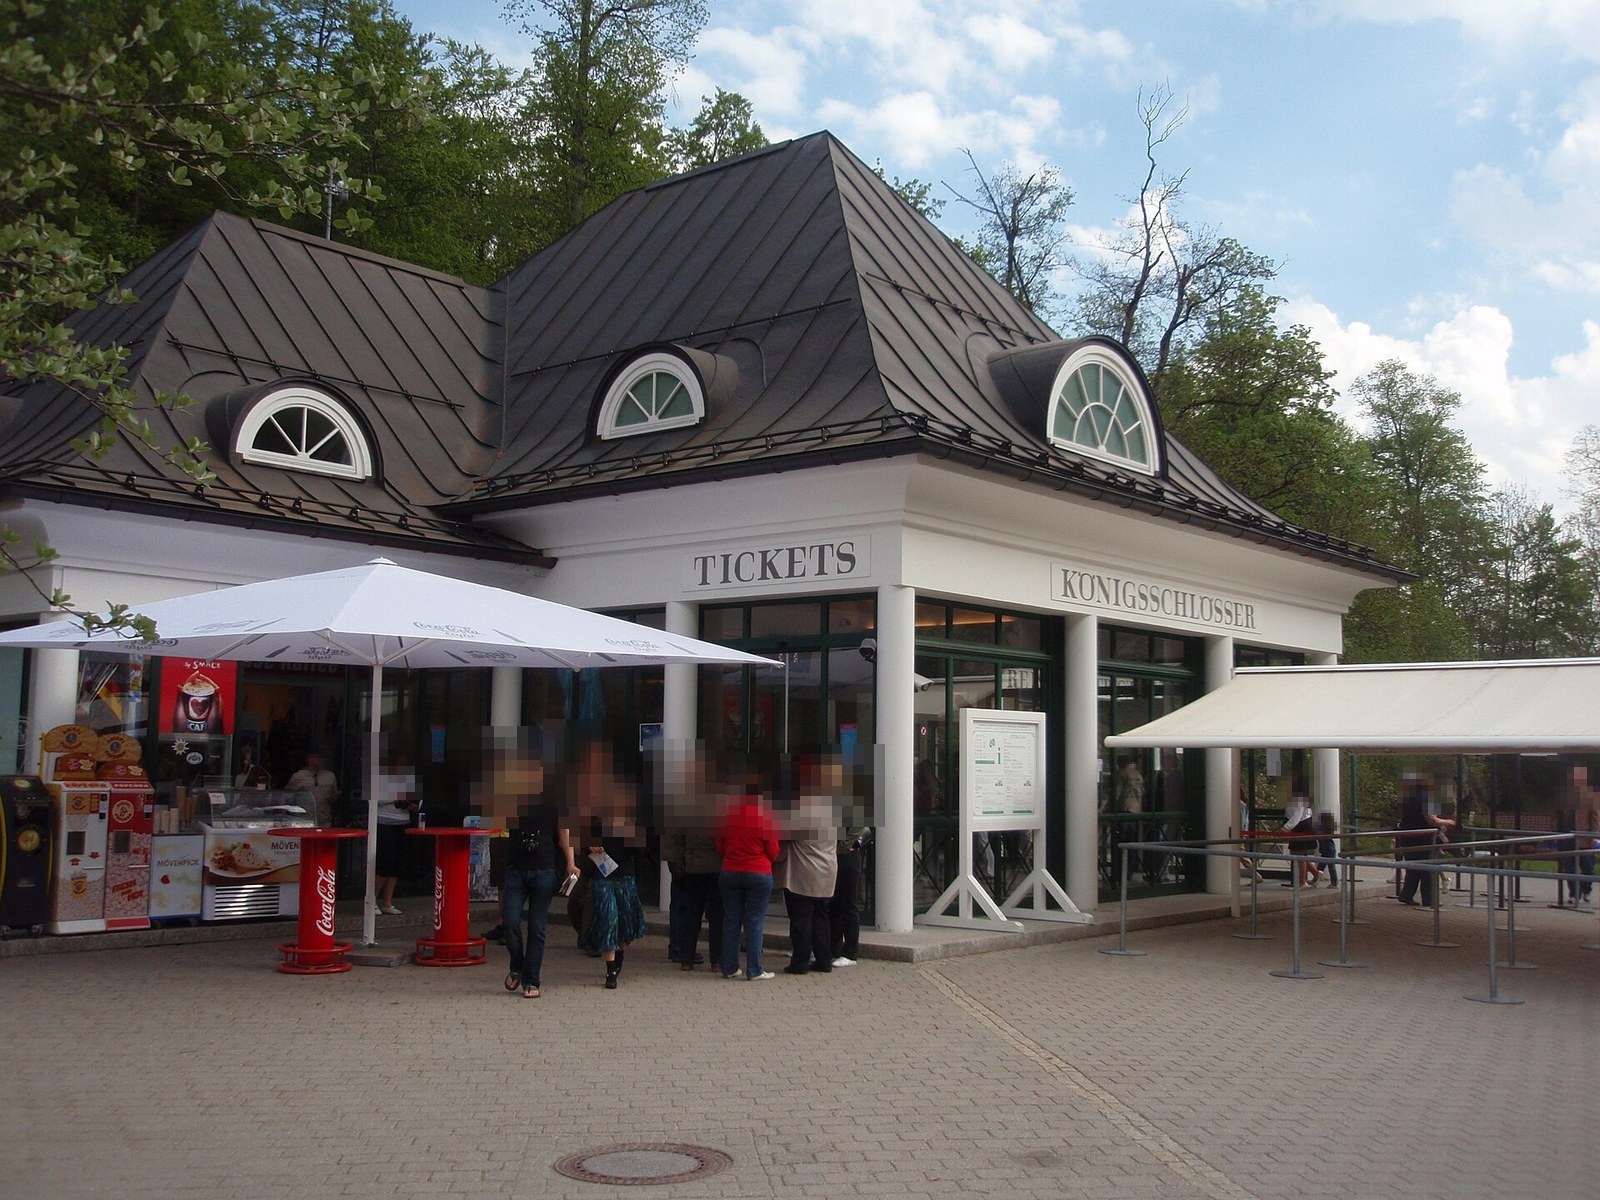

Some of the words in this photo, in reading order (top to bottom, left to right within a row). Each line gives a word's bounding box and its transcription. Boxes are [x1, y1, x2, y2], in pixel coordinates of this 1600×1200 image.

[694, 541, 856, 586] TICKETS
[1061, 568, 1256, 629] KÖNIGSSCHLÖSSER
[316, 865, 336, 936] Coca-Cola
